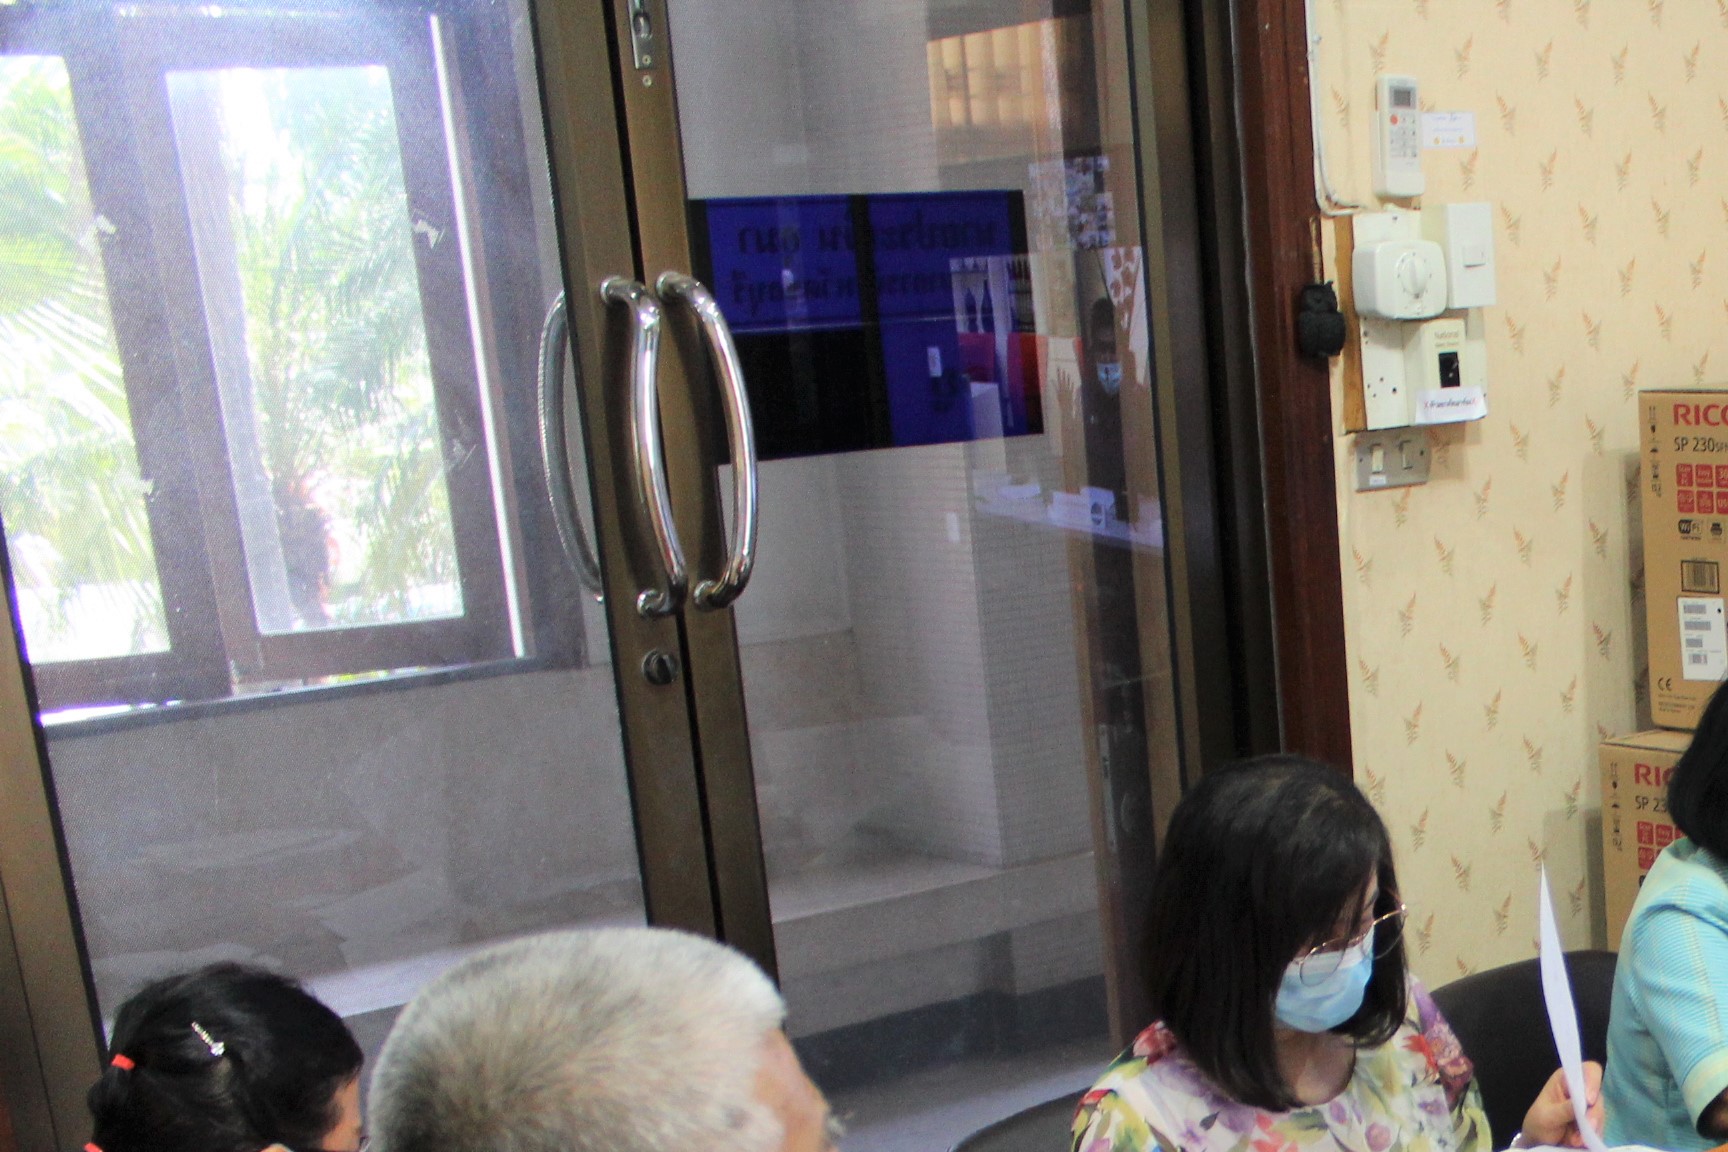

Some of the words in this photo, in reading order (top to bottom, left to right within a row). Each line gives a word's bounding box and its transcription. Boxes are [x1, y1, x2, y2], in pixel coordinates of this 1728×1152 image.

[1674, 437, 1688, 452] SP
[1634, 762, 1677, 787] RIC
[1635, 794, 1649, 810] SP
